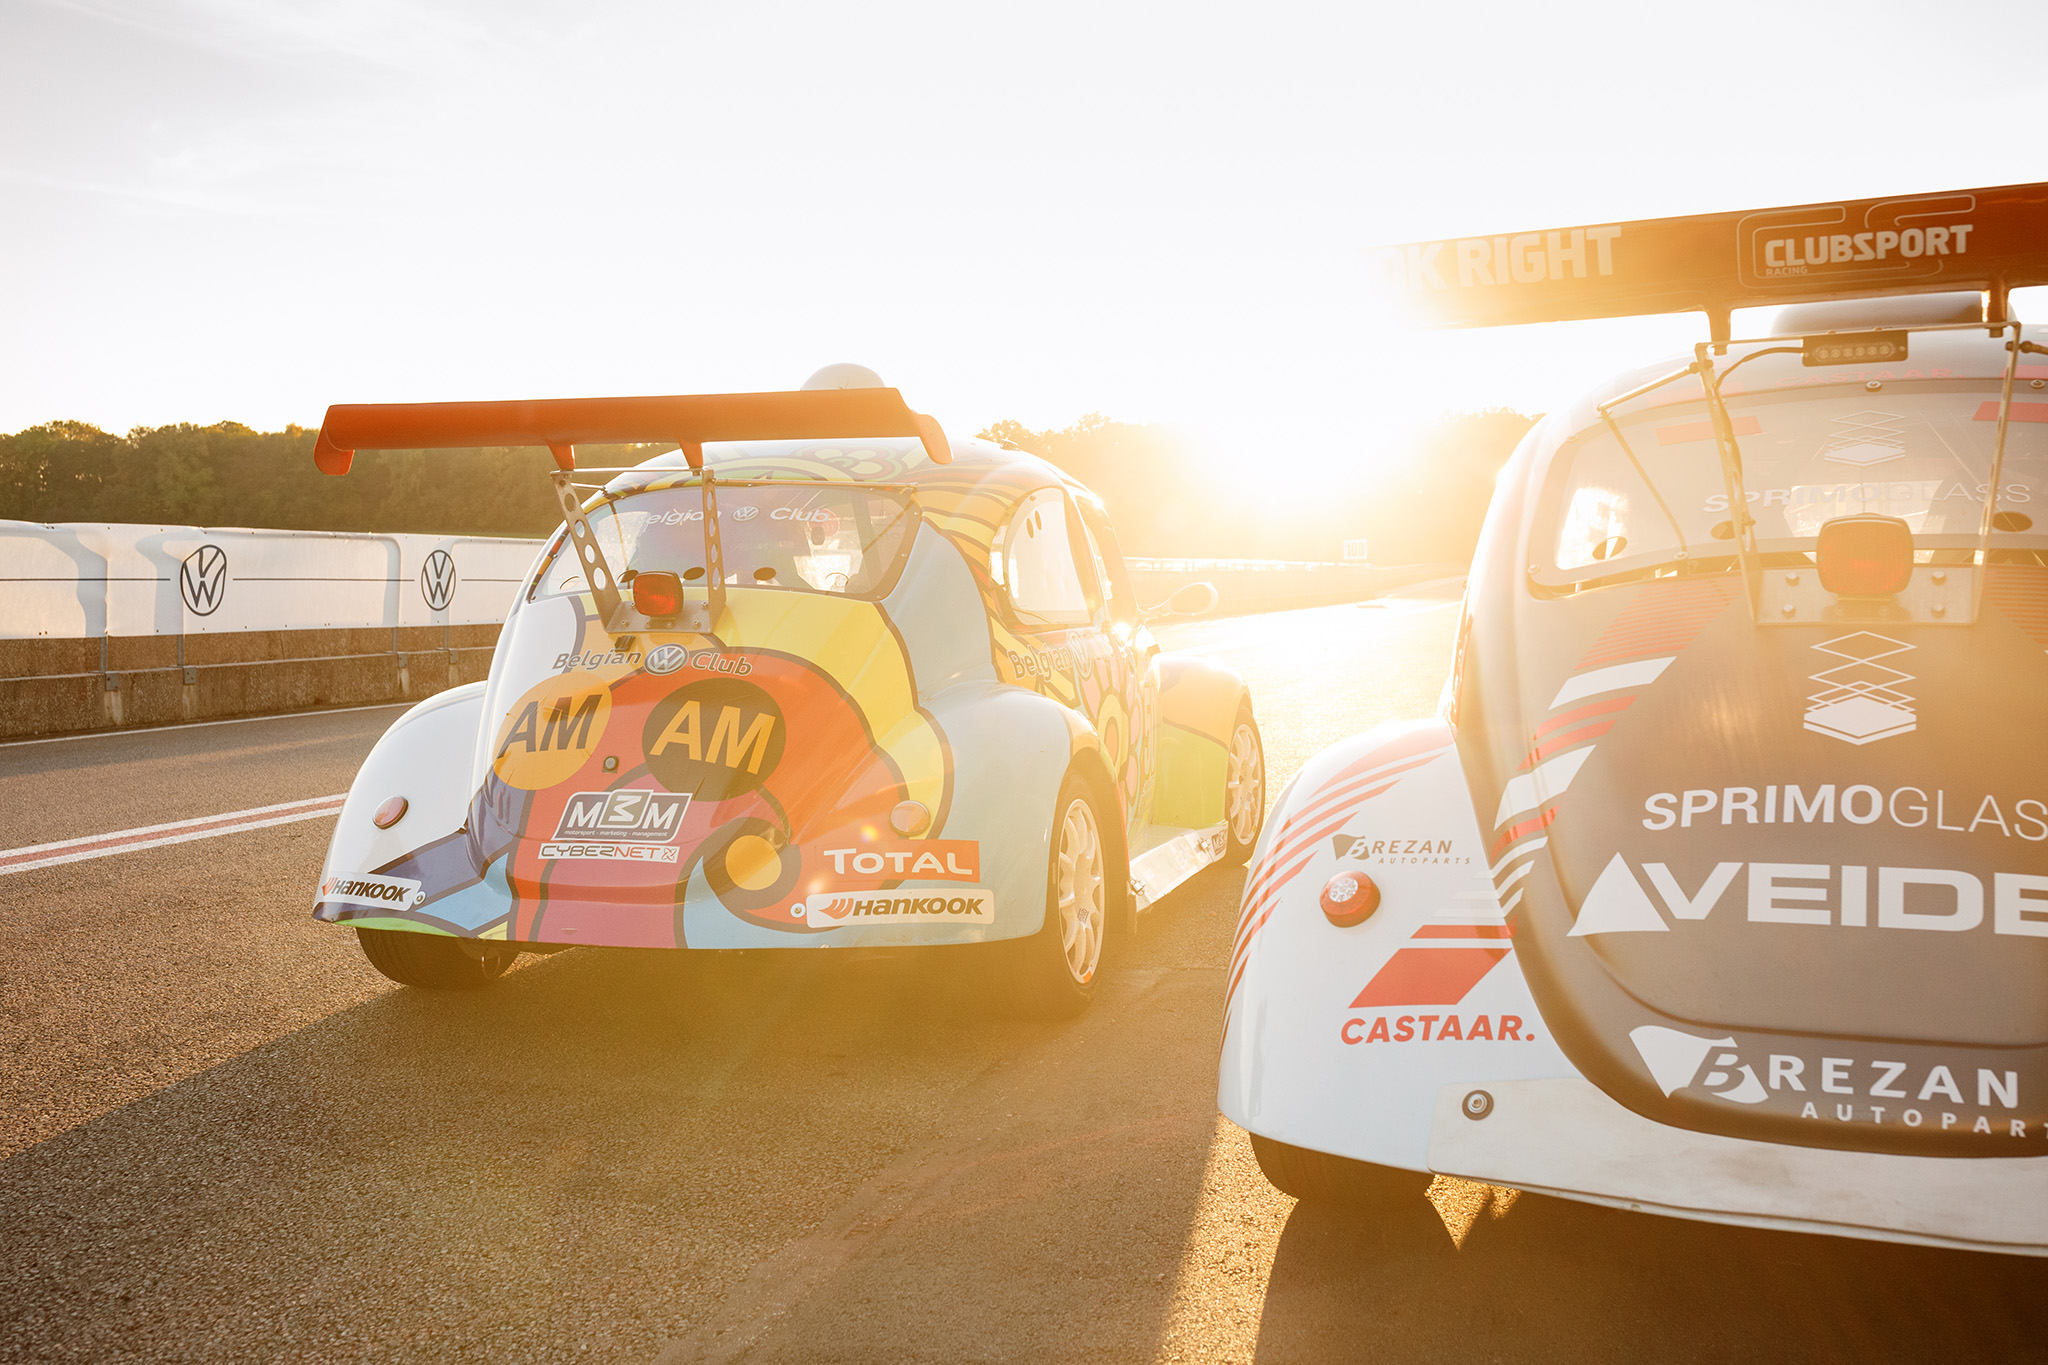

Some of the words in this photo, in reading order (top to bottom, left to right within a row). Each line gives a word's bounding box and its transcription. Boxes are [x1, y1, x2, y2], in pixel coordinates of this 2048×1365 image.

[1456, 225, 1621, 288] RIGHT
[1765, 224, 1973, 268] CLUBSPORT
[1766, 265, 1808, 277] RACING
[770, 506, 829, 523] Club
[1345, 542, 1365, 557] 100
[552, 650, 642, 671] Belgian
[691, 651, 752, 677] Club
[1007, 643, 1073, 682] Belgian
[496, 694, 603, 759] AM
[650, 700, 776, 775] AM
[564, 829, 596, 837] motorsport
[599, 830, 628, 838] marketing
[631, 830, 668, 838] management
[1378, 857, 1471, 865] AUTOPARTS
[1341, 1014, 1536, 1046] CASTAAR.
